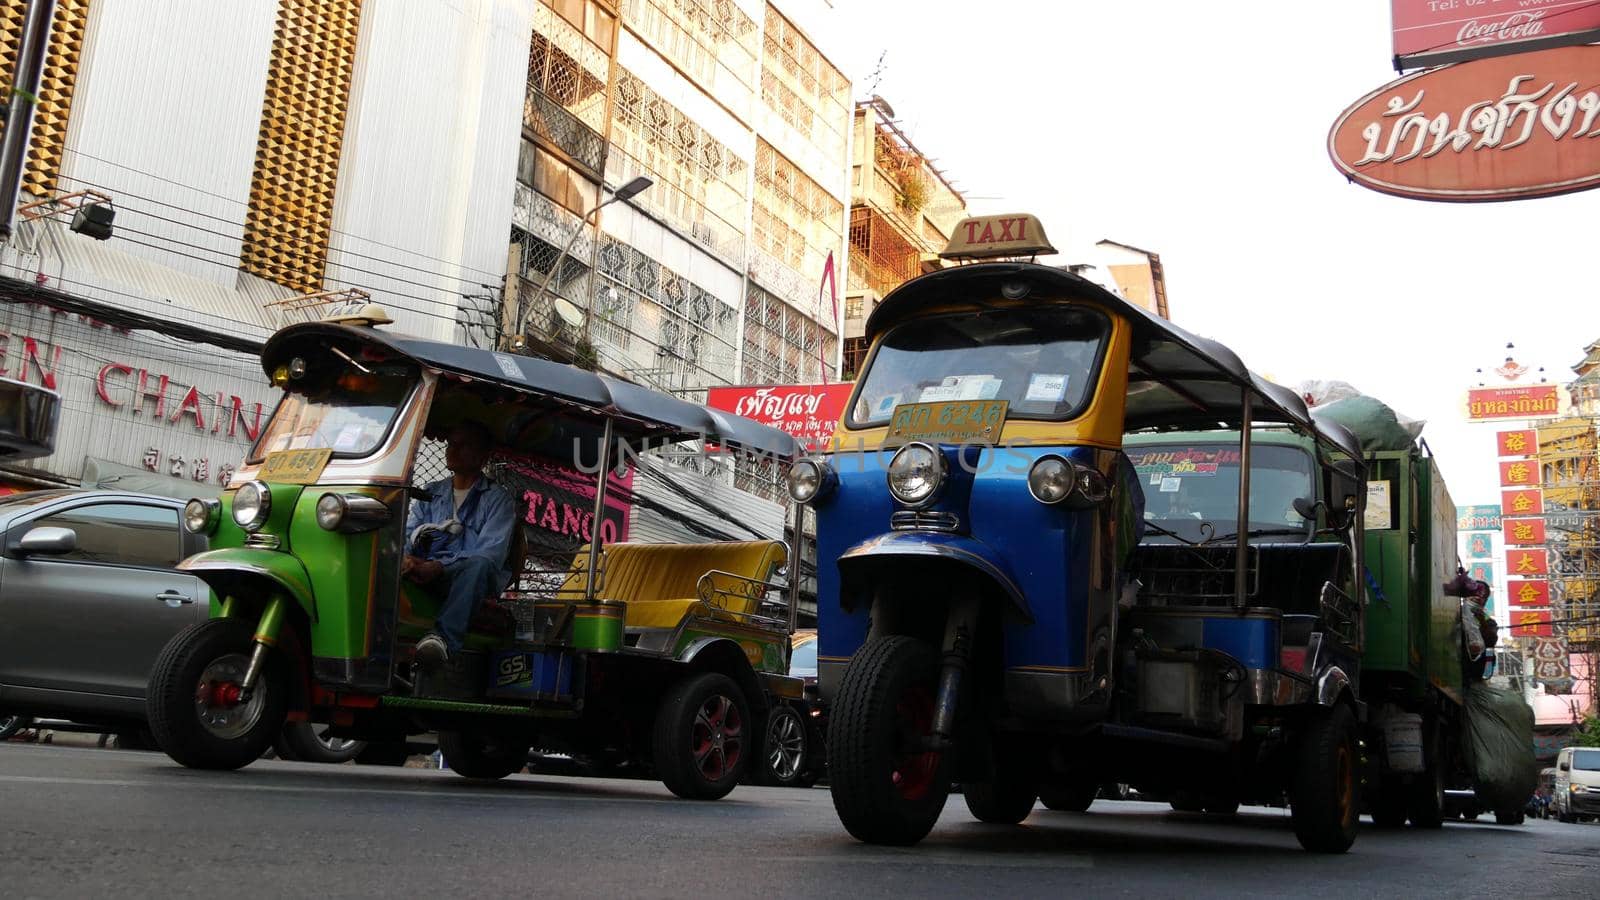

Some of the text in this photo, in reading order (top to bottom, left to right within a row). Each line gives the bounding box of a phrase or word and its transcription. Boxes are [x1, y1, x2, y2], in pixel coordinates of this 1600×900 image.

[1456, 9, 1547, 46] Coca-Cola
[963, 217, 1029, 245] TAXI
[96, 363, 264, 442] CHAIN
[937, 401, 1003, 425] 6246
